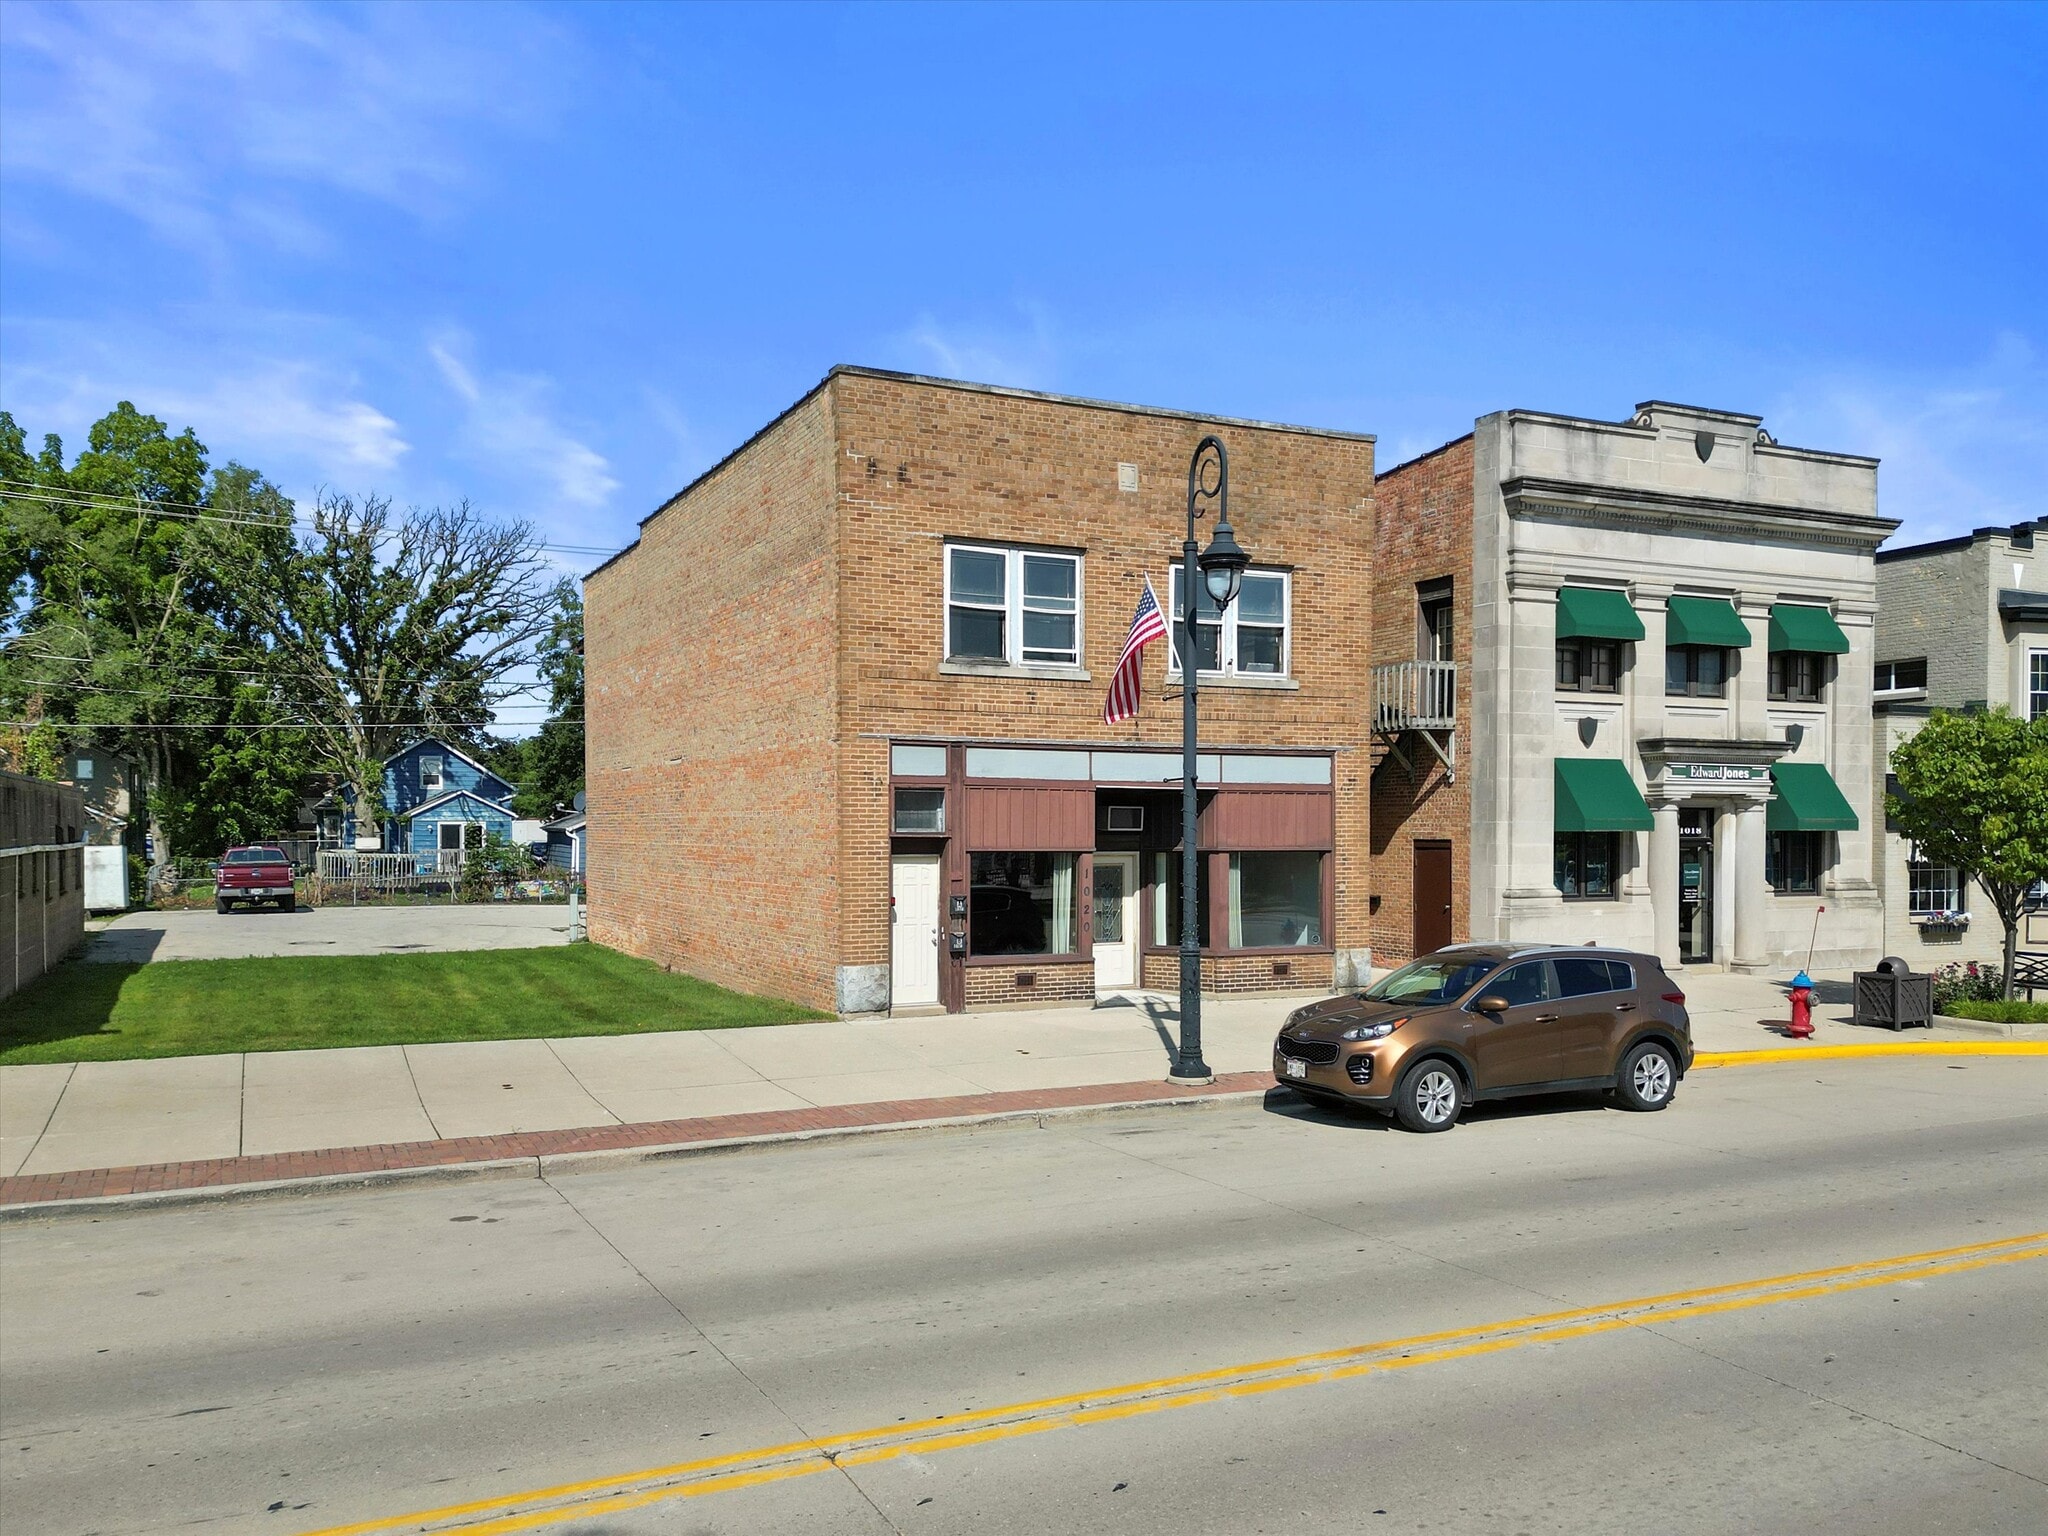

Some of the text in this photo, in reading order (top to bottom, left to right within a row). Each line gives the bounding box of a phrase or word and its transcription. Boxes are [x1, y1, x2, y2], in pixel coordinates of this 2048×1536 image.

[1690, 765, 1750, 780] Edward Jones
[1680, 827, 1702, 835] 1018
